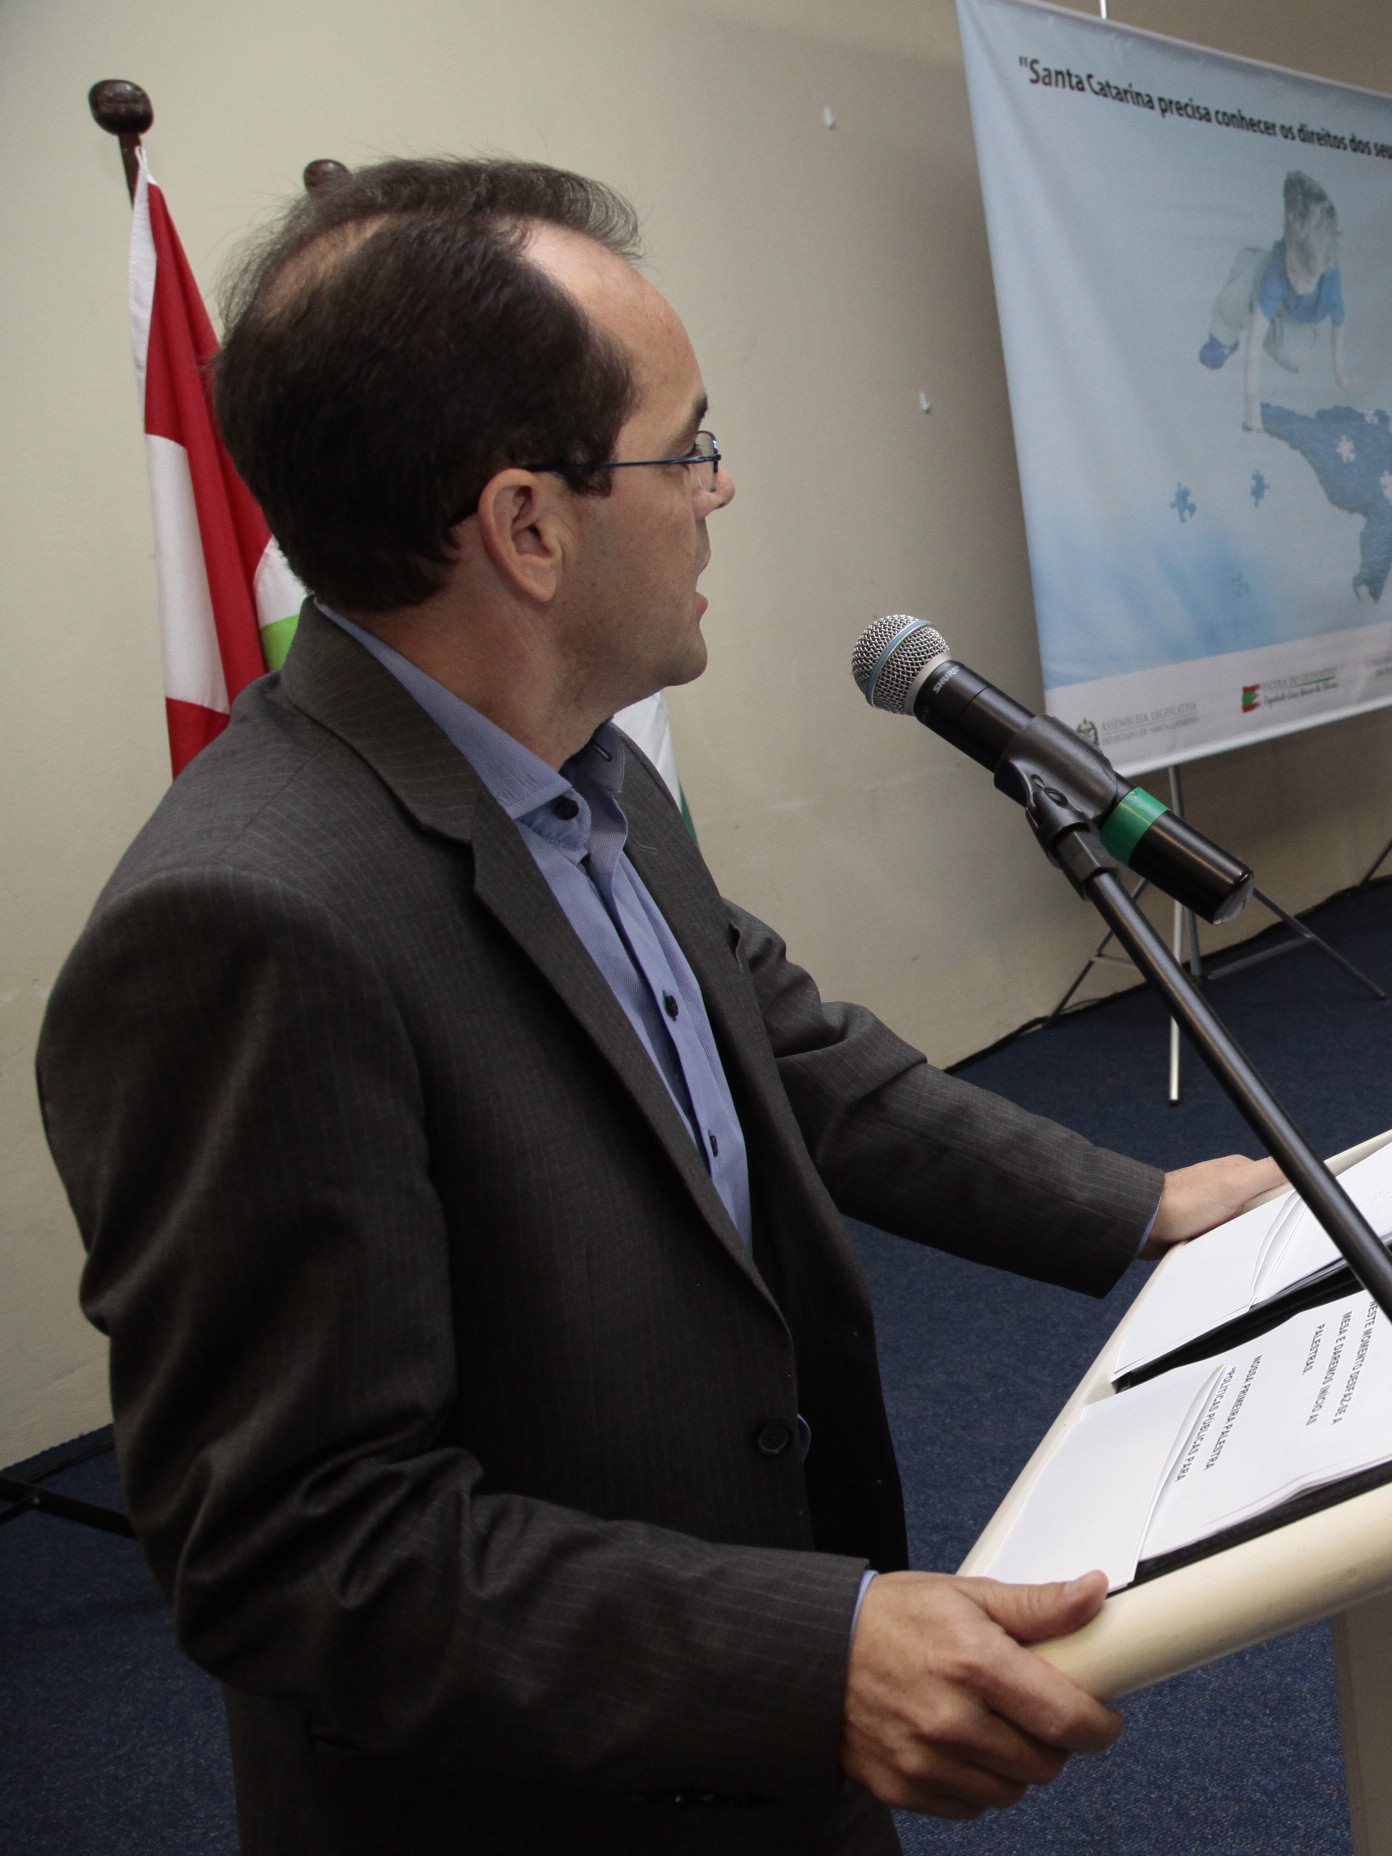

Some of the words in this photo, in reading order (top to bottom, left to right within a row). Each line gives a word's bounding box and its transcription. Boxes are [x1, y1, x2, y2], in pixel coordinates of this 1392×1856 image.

[1086, 73, 1155, 111] Catarina
[1157, 97, 1212, 118] precisa
[1215, 108, 1277, 137] conhecer
[1279, 124, 1296, 141] os
[1297, 122, 1348, 151] direitos
[1349, 133, 1372, 156] dos
[933, 665, 960, 694] SHURE
[1337, 1310, 1353, 1337] MESA
[1363, 1300, 1378, 1329] NESTE
[1335, 1336, 1346, 1344] E
[1352, 1327, 1373, 1372] MOMENTO
[1243, 1354, 1263, 1384] NOSSA
[1322, 1342, 1344, 1386] DAREMOS
[1226, 1382, 1251, 1424] PRIMEIRA
[1334, 1370, 1360, 1418] DESFAZ-SE
[1188, 1412, 1216, 1456] PÚBLICAS
[1331, 1417, 1343, 1425] A
[1203, 1423, 1233, 1471] PALESTRA
[1175, 1455, 1196, 1483] PARA
